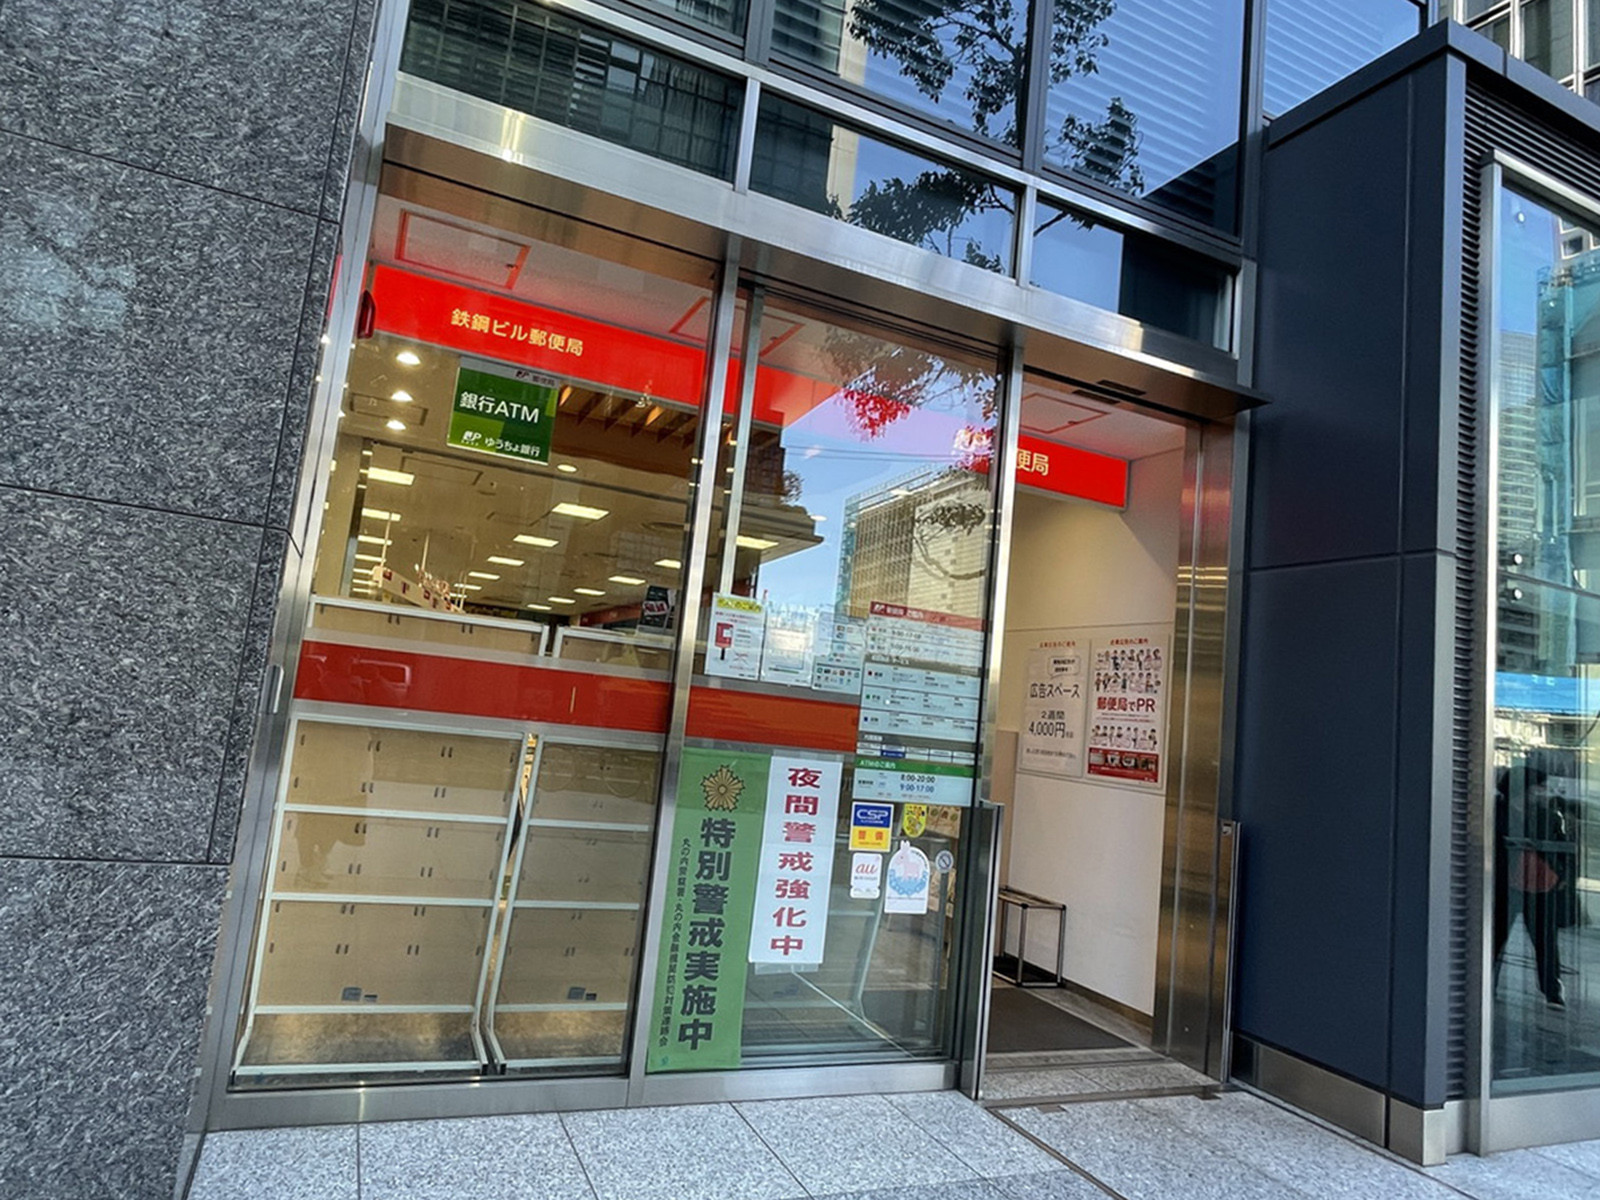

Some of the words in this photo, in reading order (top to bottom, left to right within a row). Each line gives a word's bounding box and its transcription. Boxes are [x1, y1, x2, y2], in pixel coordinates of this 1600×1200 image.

[450, 308, 584, 357] 鉄鋼ビル郵便局
[460, 391, 539, 424] 銀行ATM
[484, 437, 541, 457] ゆうちょ銀行
[1029, 682, 1080, 699] 広告スペース
[1097, 697, 1156, 713] 郵便局でPR
[1028, 721, 1066, 739] 4,000円
[856, 808, 889, 820] CSP
[770, 767, 823, 956] 夜間警戒強化中
[855, 863, 878, 875] au
[677, 817, 736, 1051] 特別警戒実施中
